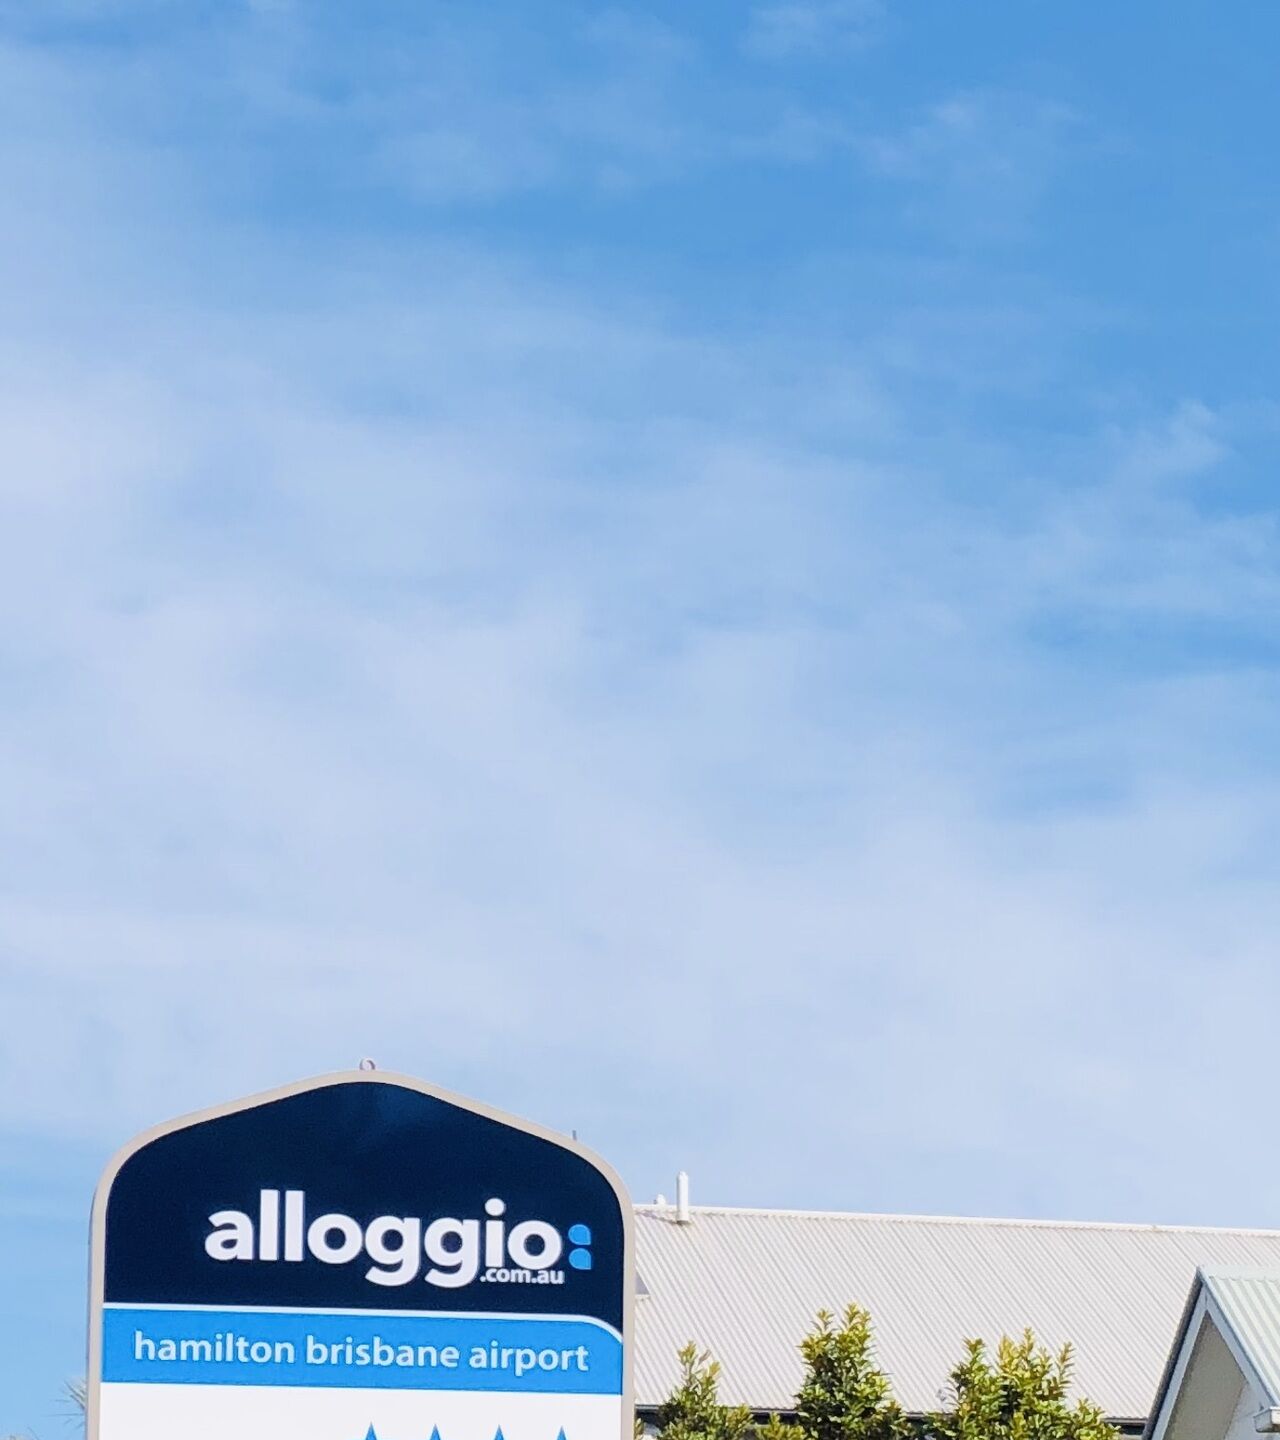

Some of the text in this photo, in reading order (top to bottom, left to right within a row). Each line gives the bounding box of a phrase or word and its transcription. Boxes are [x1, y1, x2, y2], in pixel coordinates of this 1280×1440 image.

[479, 1266, 564, 1285] .com.au
[134, 1331, 589, 1377] hamilton brisbane airport
